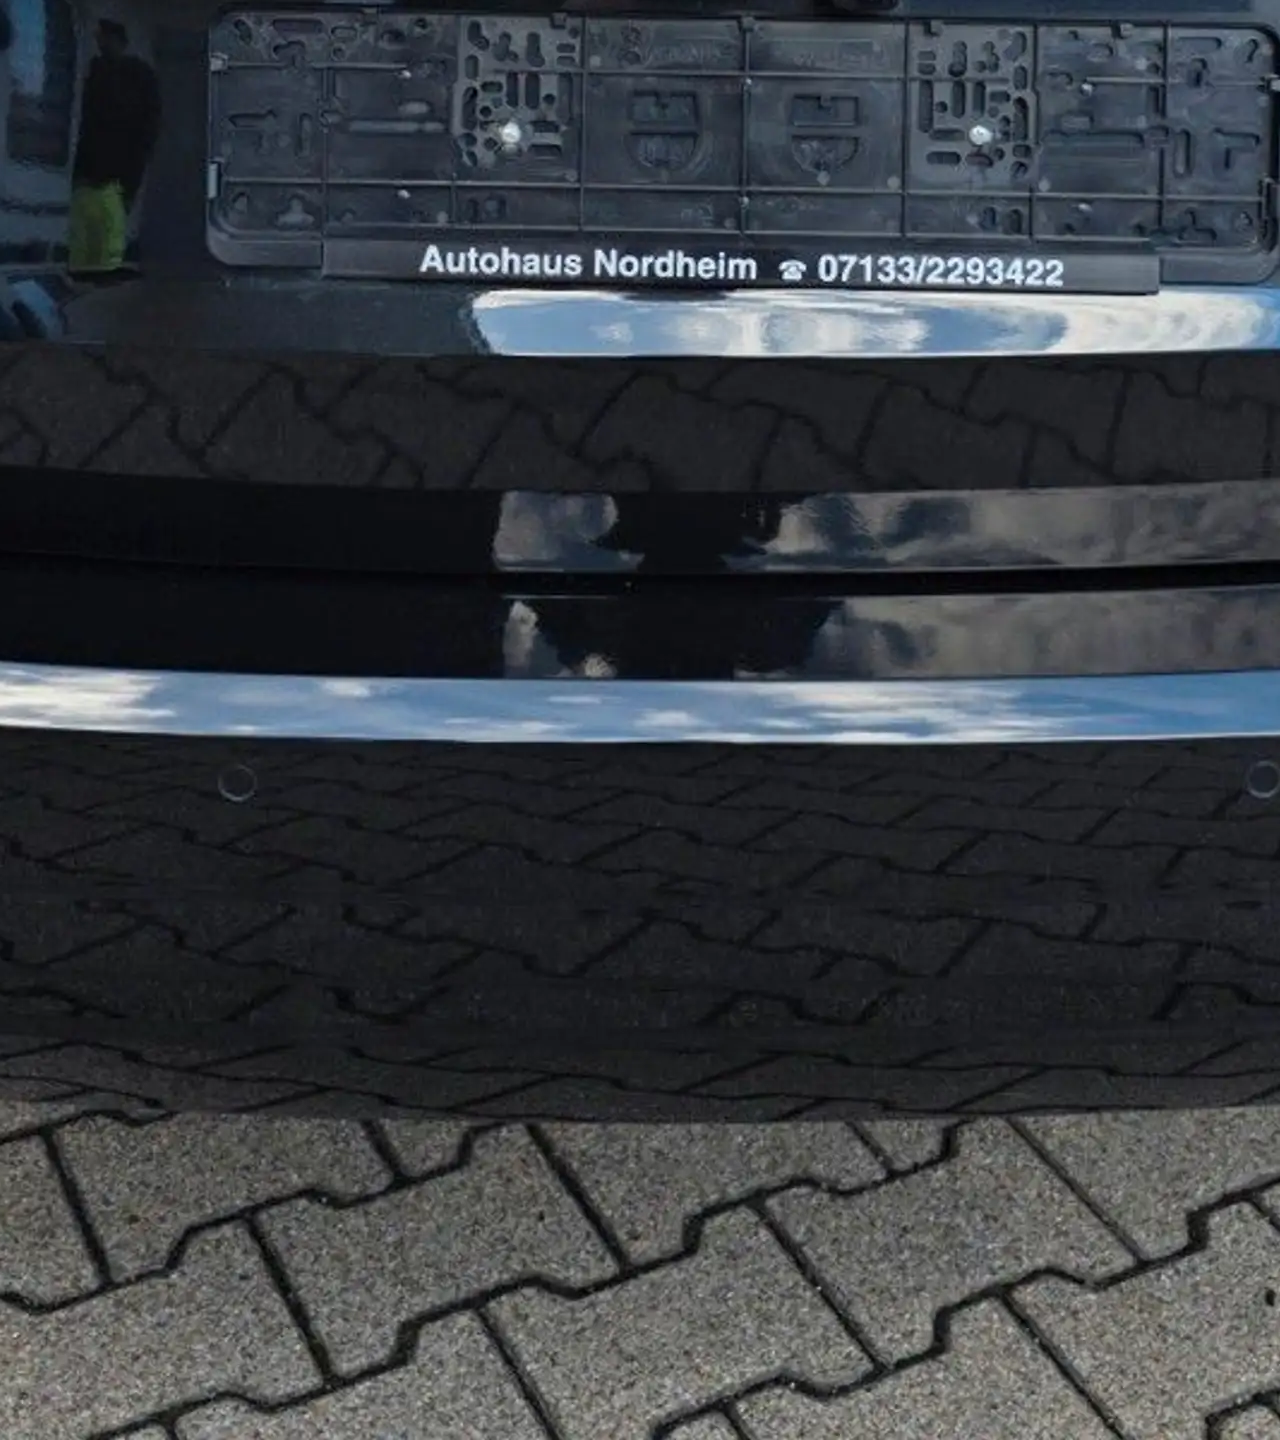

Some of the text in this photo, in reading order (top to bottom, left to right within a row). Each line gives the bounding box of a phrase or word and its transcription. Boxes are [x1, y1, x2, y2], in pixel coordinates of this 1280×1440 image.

[419, 243, 1065, 288] Autohaus Nordheim 07133/2293422
